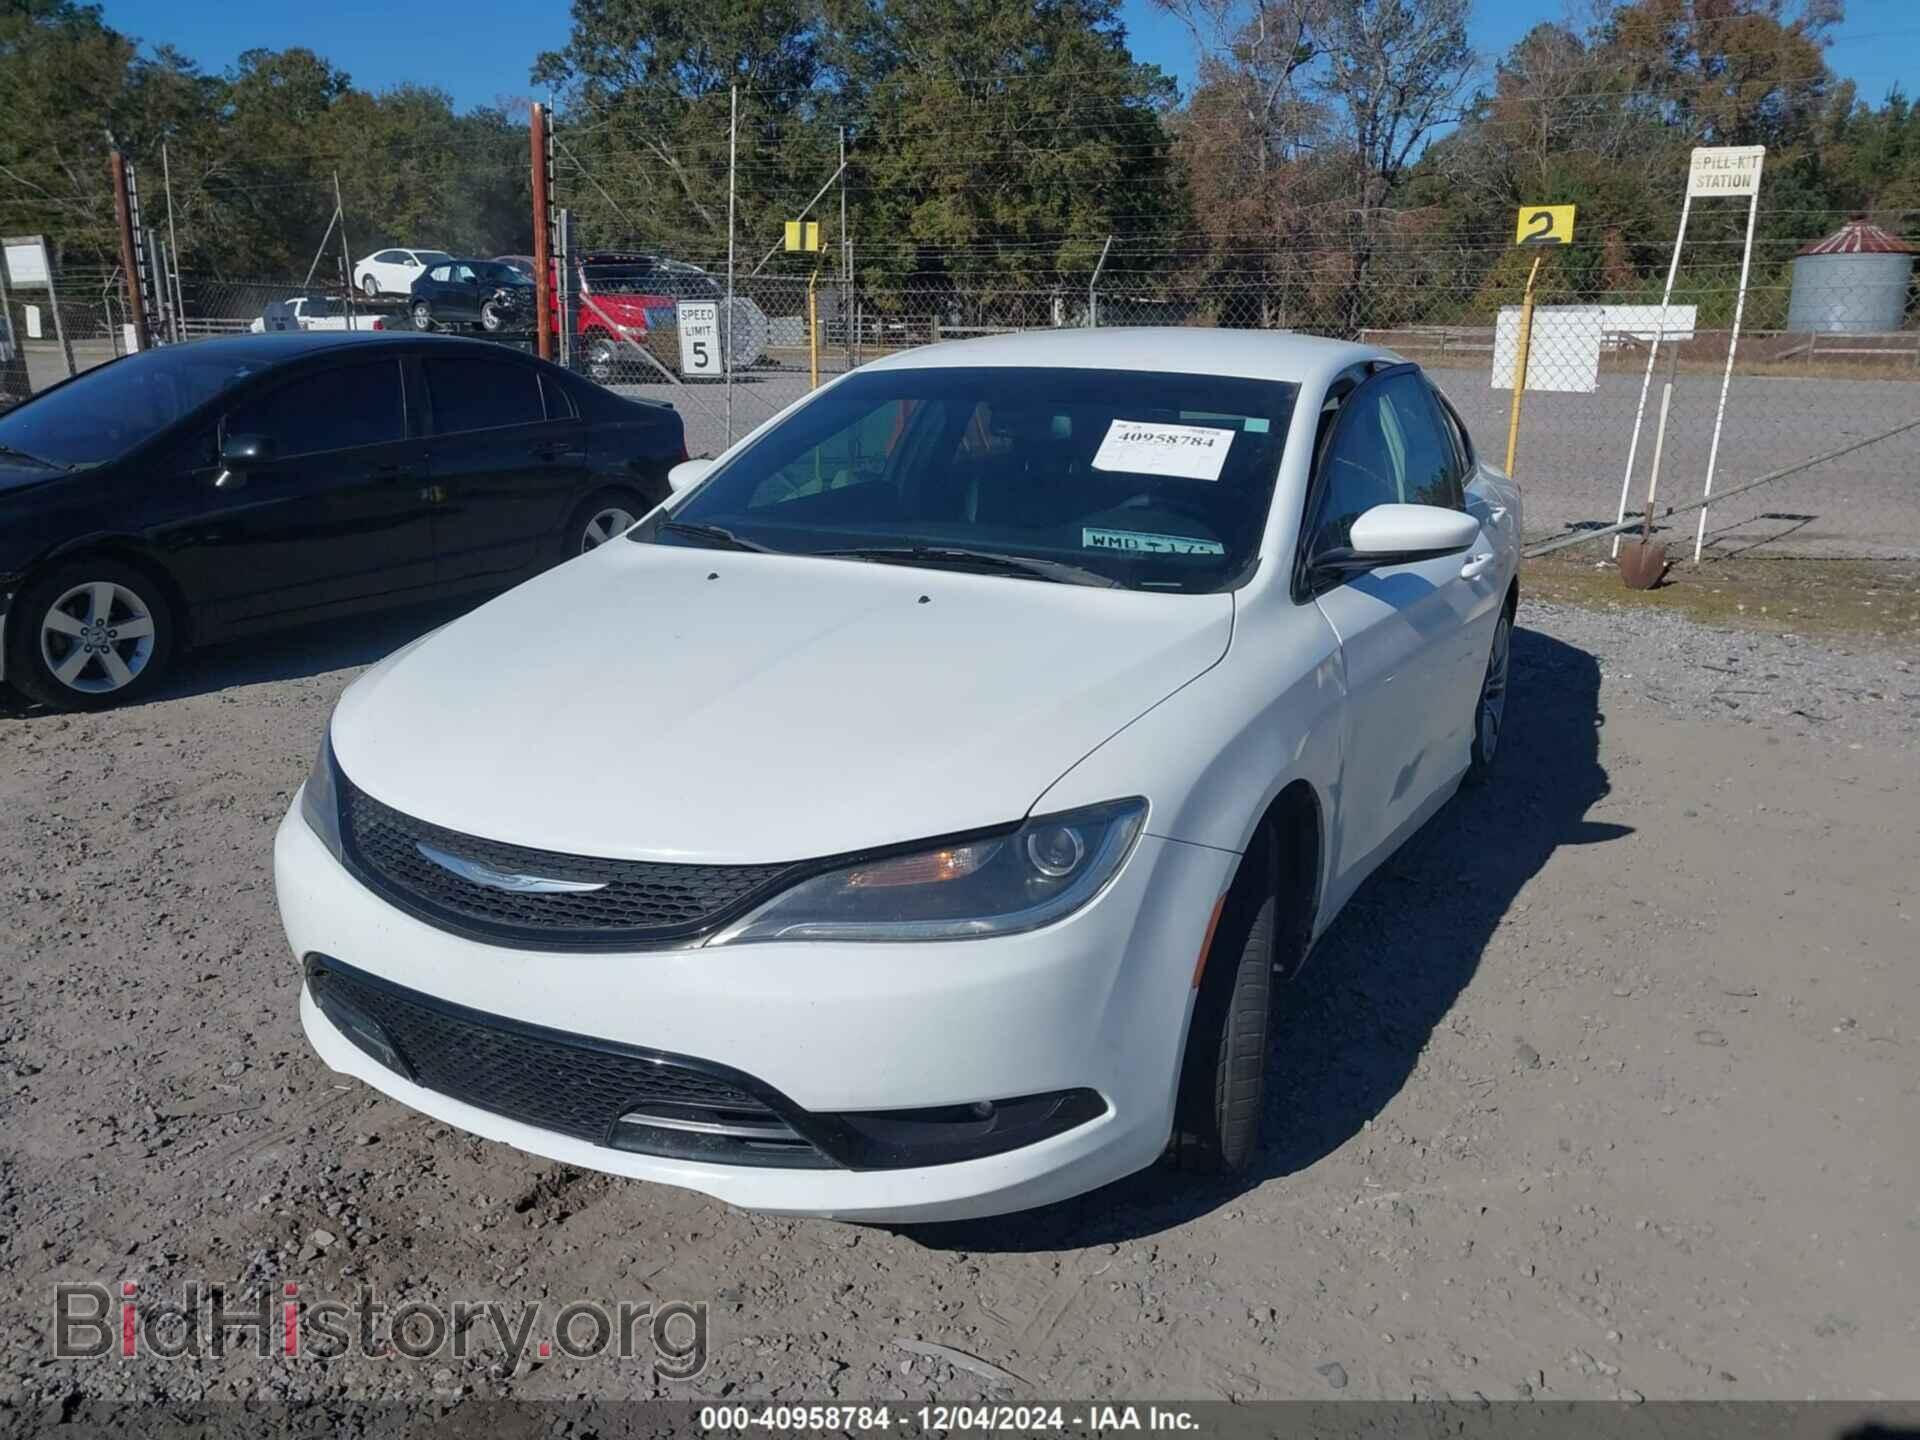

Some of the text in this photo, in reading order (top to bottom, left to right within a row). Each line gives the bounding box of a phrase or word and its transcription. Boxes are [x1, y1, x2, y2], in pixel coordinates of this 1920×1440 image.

[1695, 155, 1760, 169] SPILL-KT
[1696, 174, 1752, 188] STATION
[1519, 211, 1563, 244] 2
[681, 309, 714, 321] SPEED
[685, 326, 711, 337] LIMIT
[693, 342, 708, 367] 5
[1118, 432, 1215, 447] 40958784
